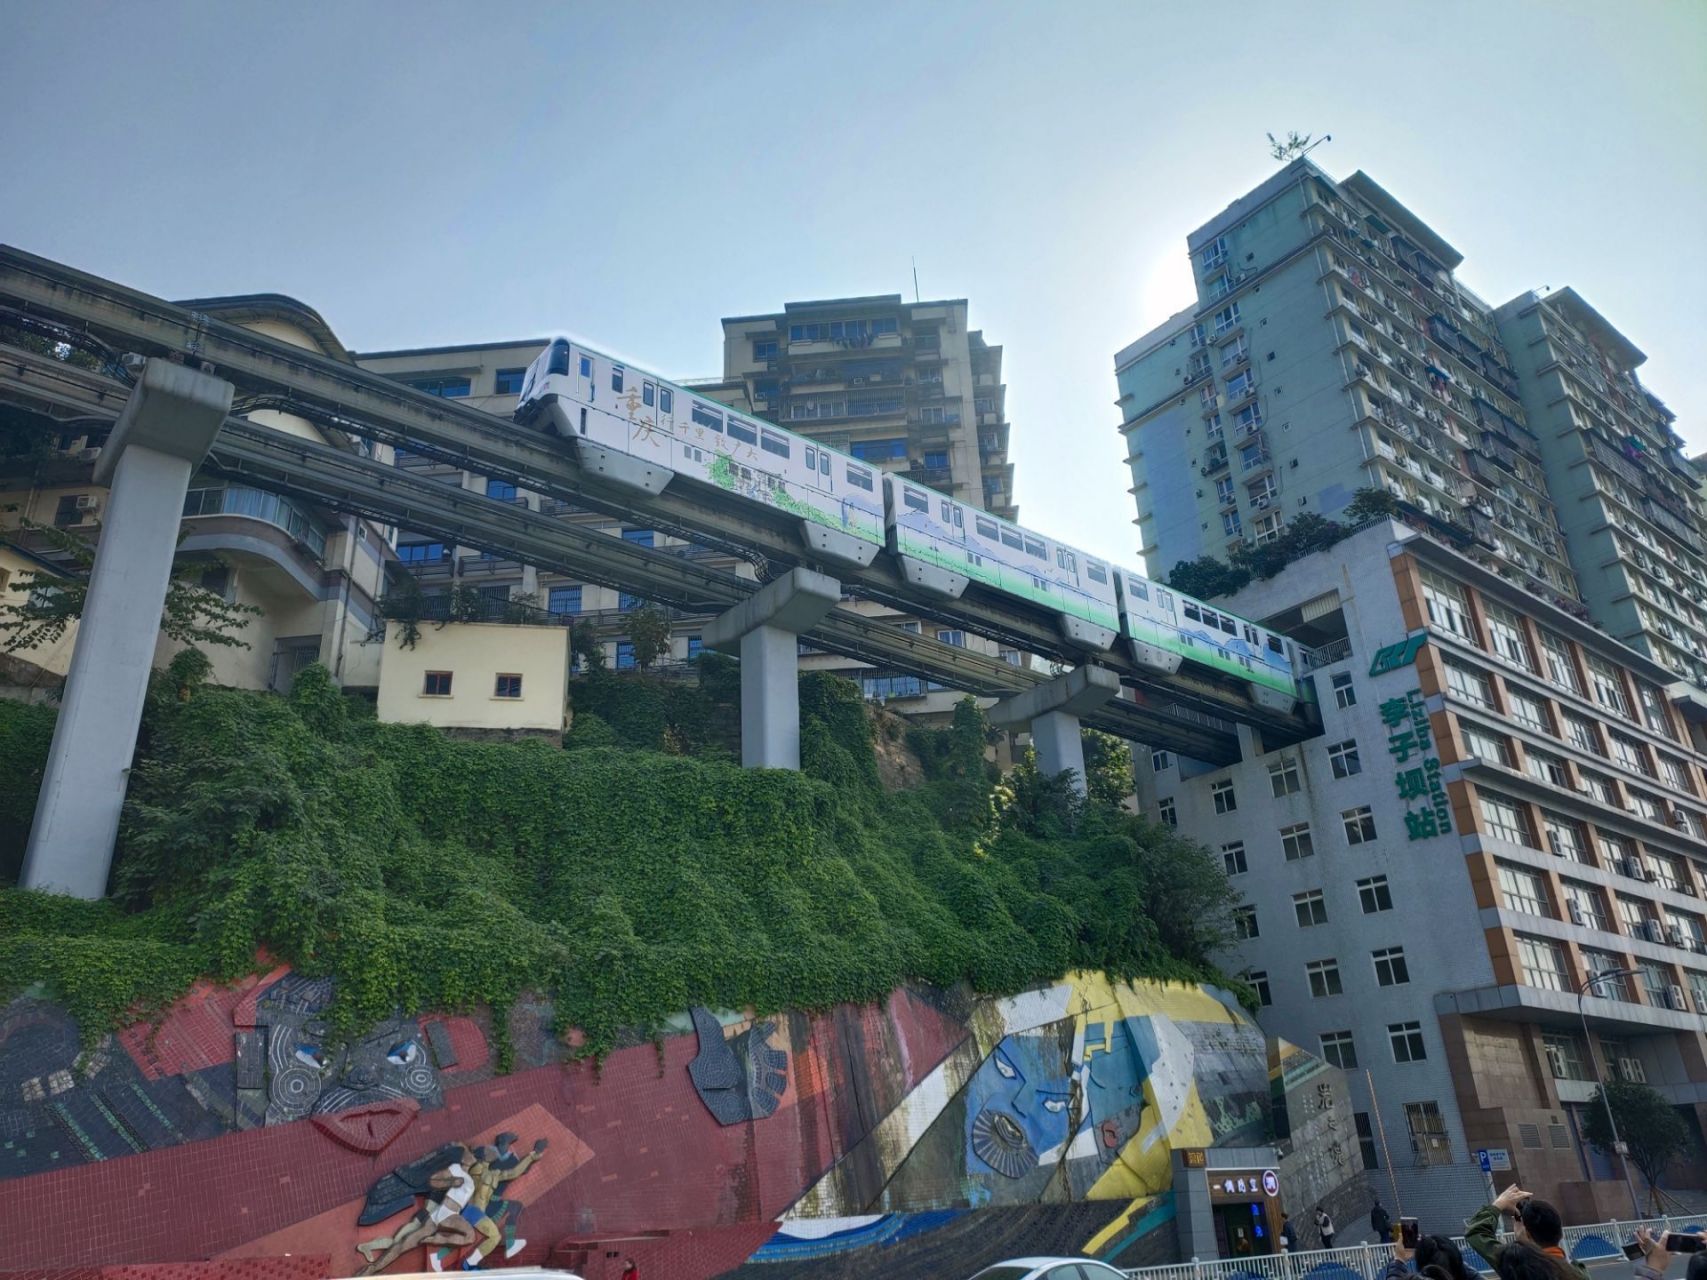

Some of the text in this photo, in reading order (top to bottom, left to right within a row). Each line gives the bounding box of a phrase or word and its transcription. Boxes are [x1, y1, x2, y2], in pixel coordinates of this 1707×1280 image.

[617, 386, 661, 448] 重庆
[1379, 697, 1439, 841] 李子坝站
[1406, 688, 1452, 834] Liziba Station
